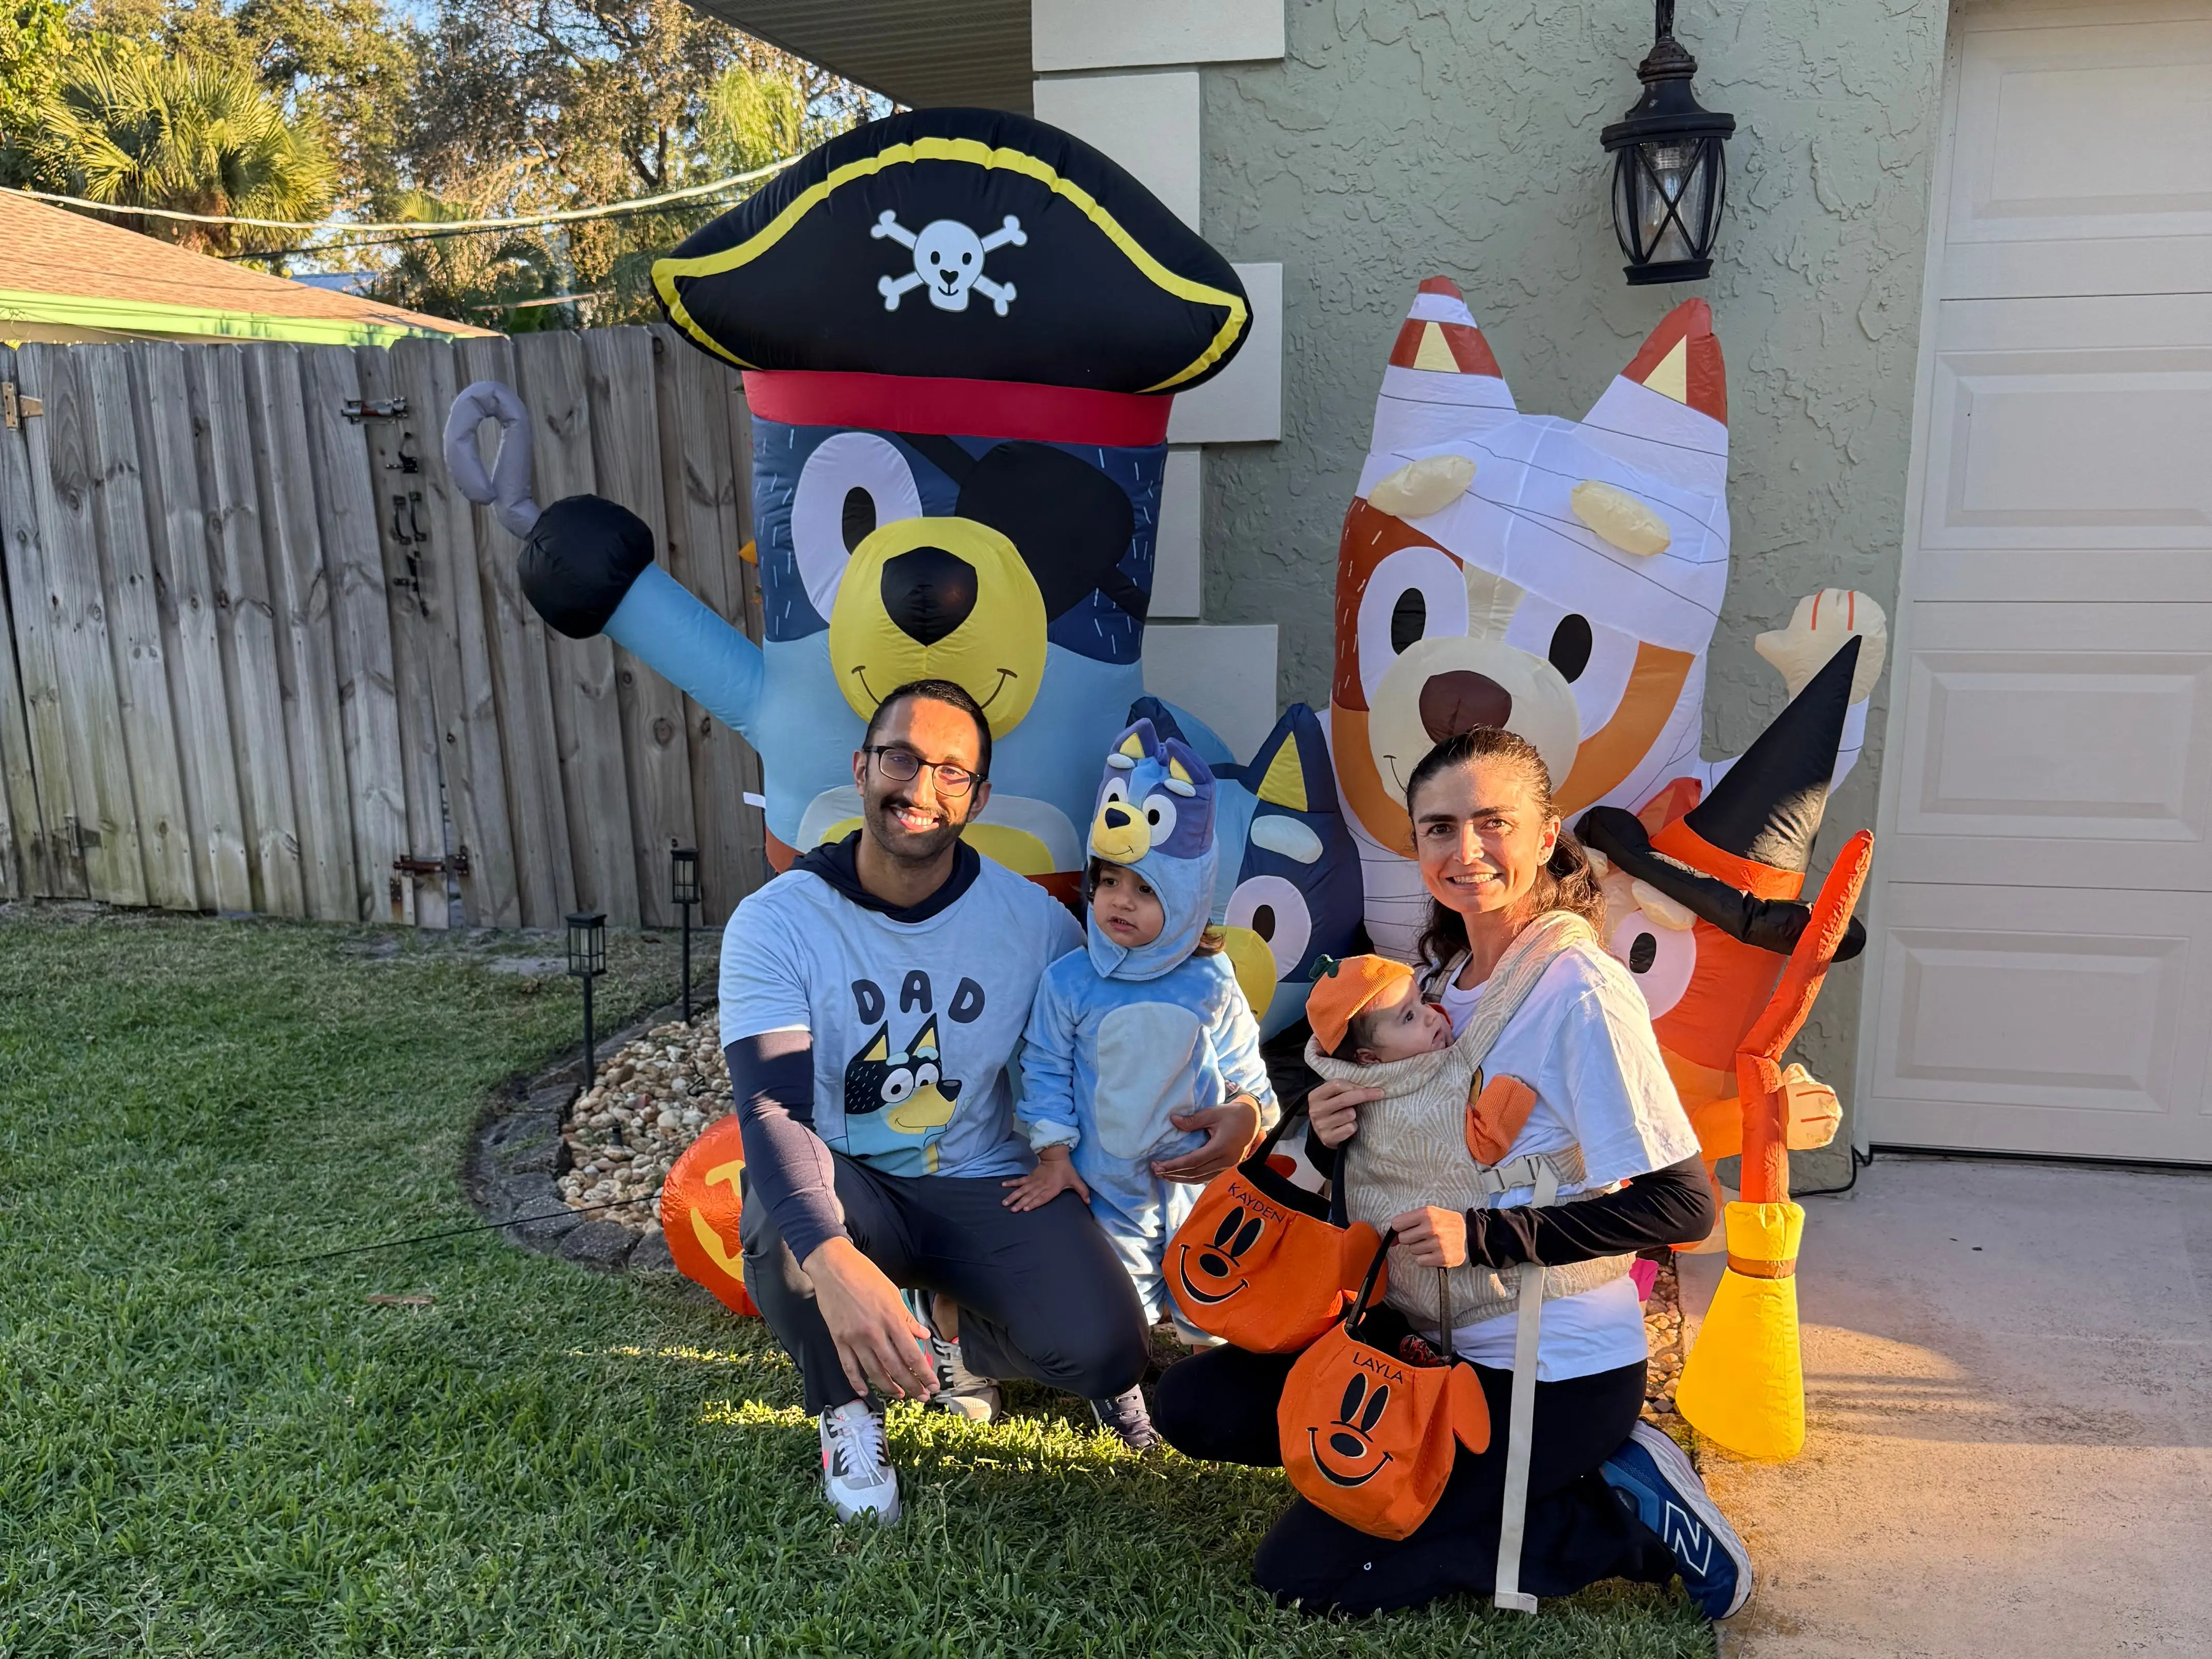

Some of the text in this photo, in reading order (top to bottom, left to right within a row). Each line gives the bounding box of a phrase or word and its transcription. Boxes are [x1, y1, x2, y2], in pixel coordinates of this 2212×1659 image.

[851, 970, 985, 1025] DAD
[1228, 1182, 1285, 1224] KAYDEN
[1353, 1352, 1403, 1384] LAYLA
[1664, 1499, 1712, 1577] N
